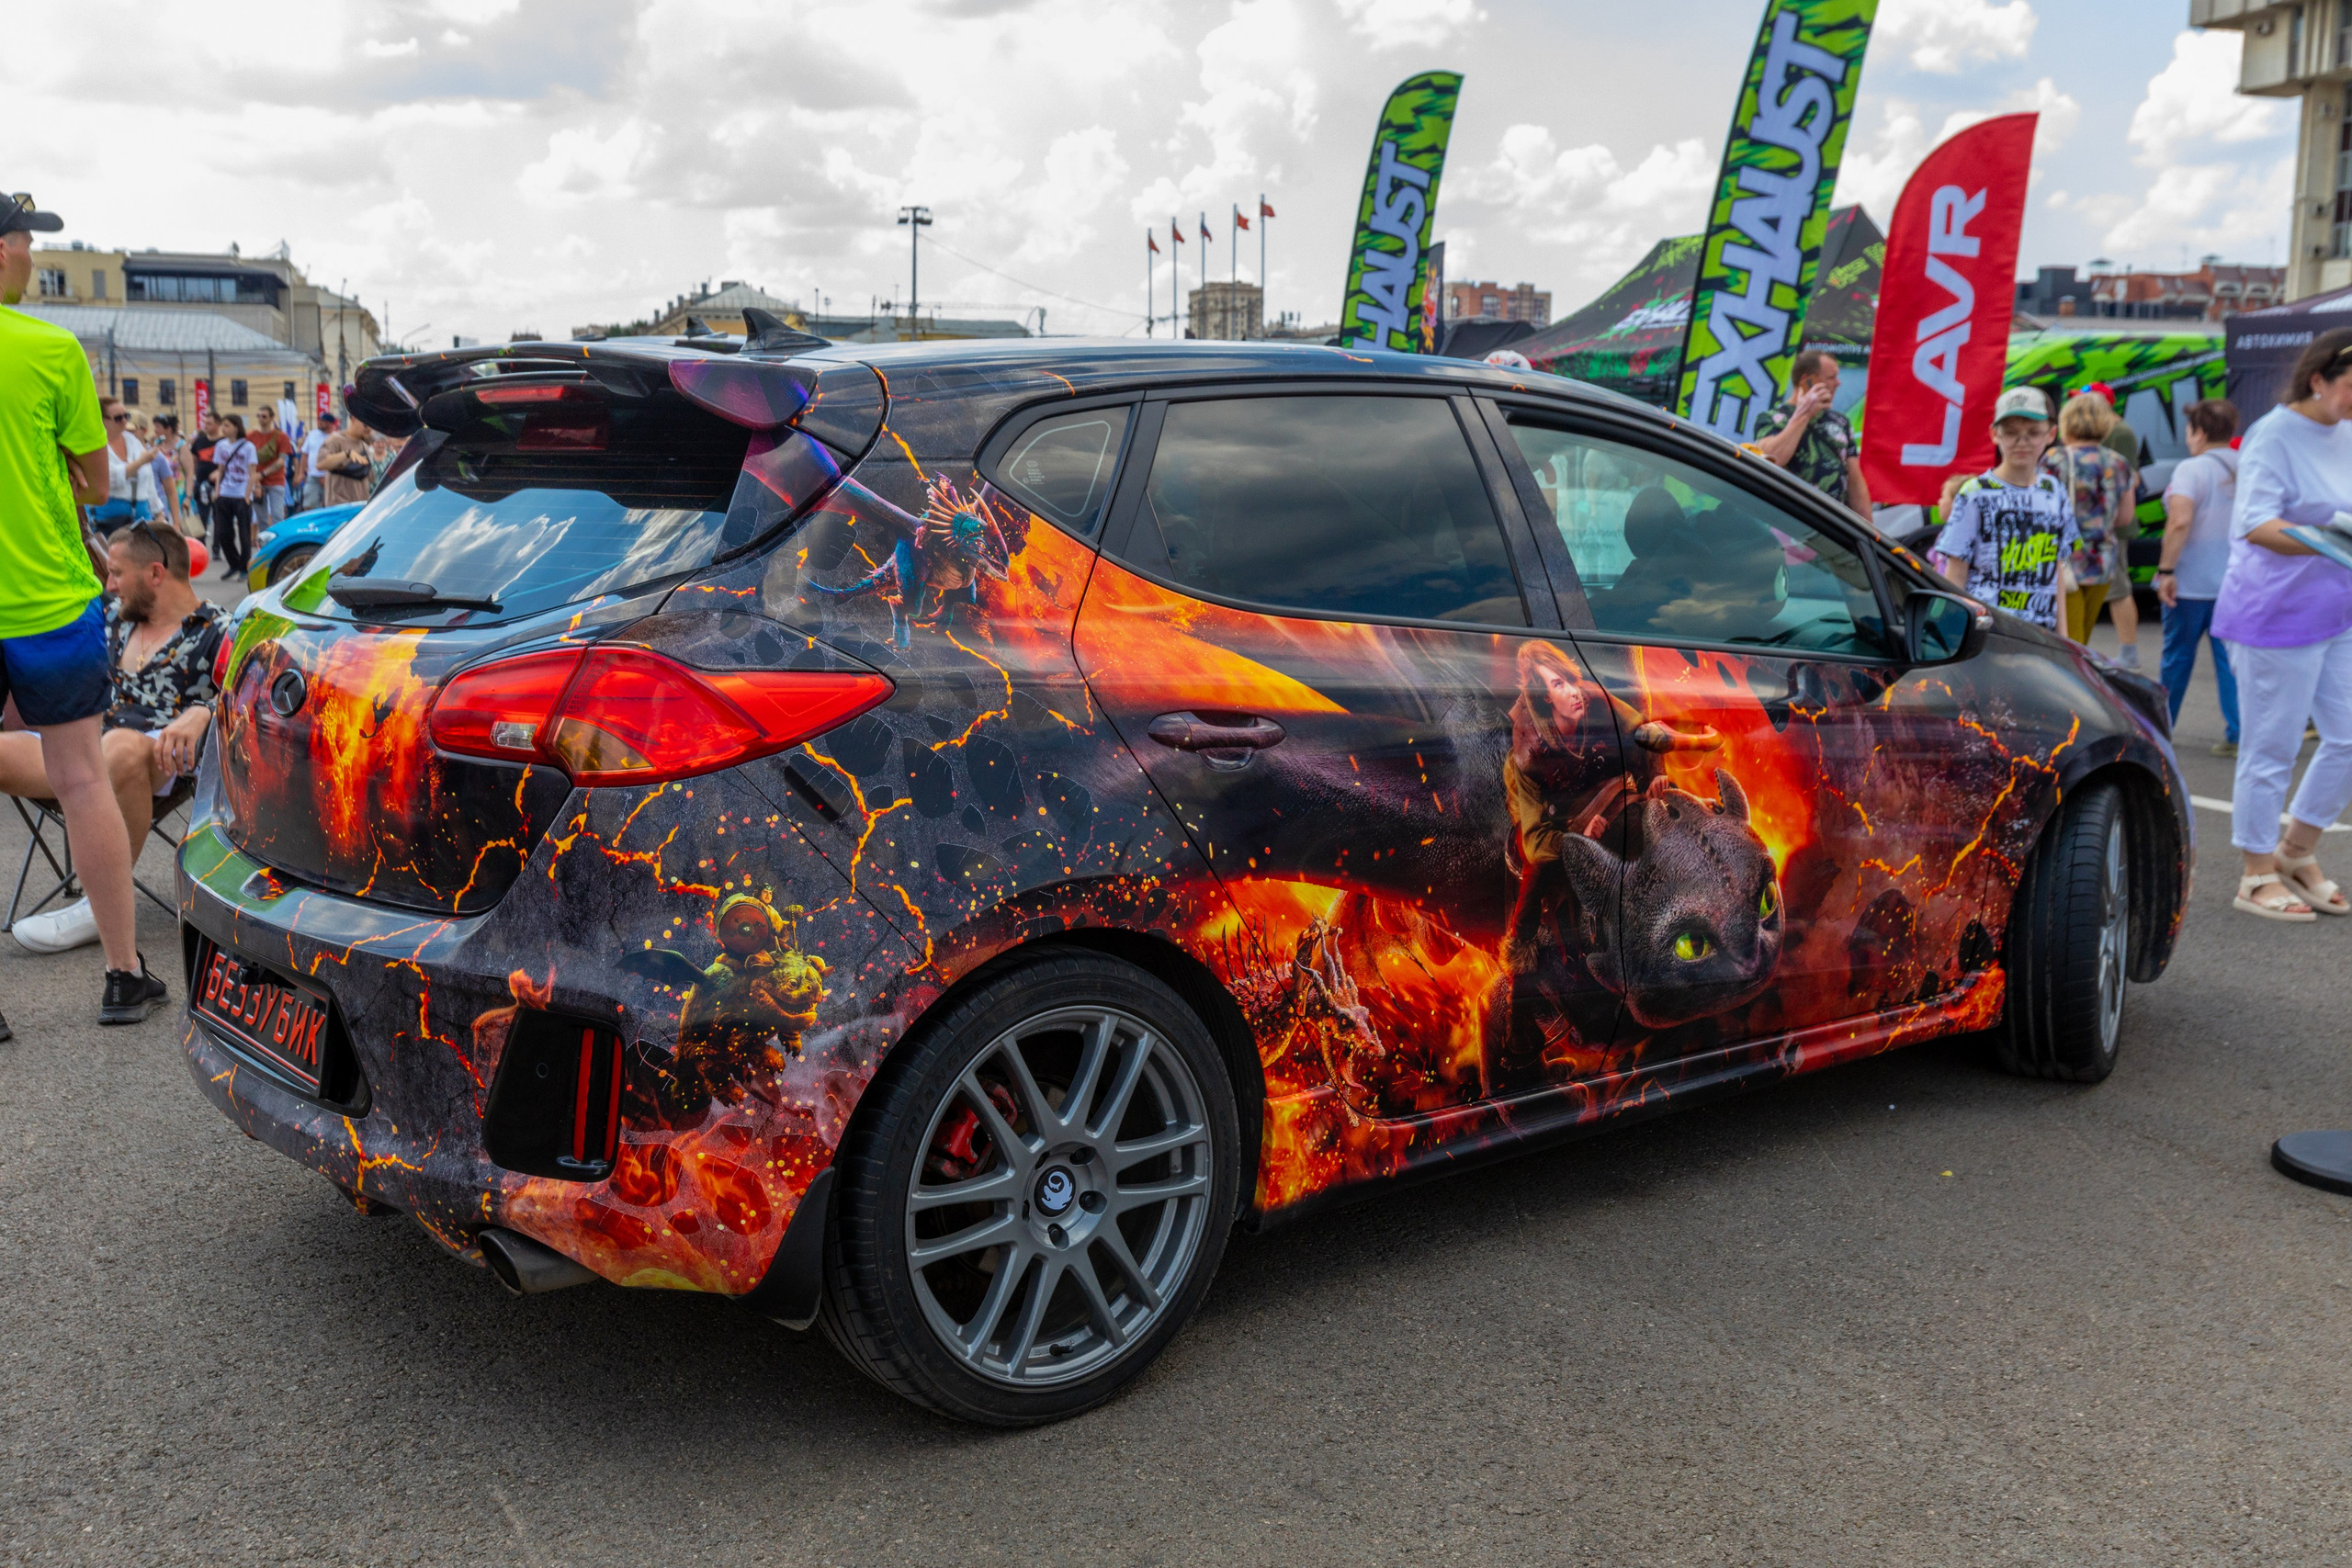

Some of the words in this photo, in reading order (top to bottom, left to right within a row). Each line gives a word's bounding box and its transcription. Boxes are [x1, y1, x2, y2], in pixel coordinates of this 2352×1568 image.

[1690, 9, 1847, 444] EXHAUST
[1900, 184, 1987, 467] LAVR
[206, 952, 326, 1066] БЕЗЗУБИК
